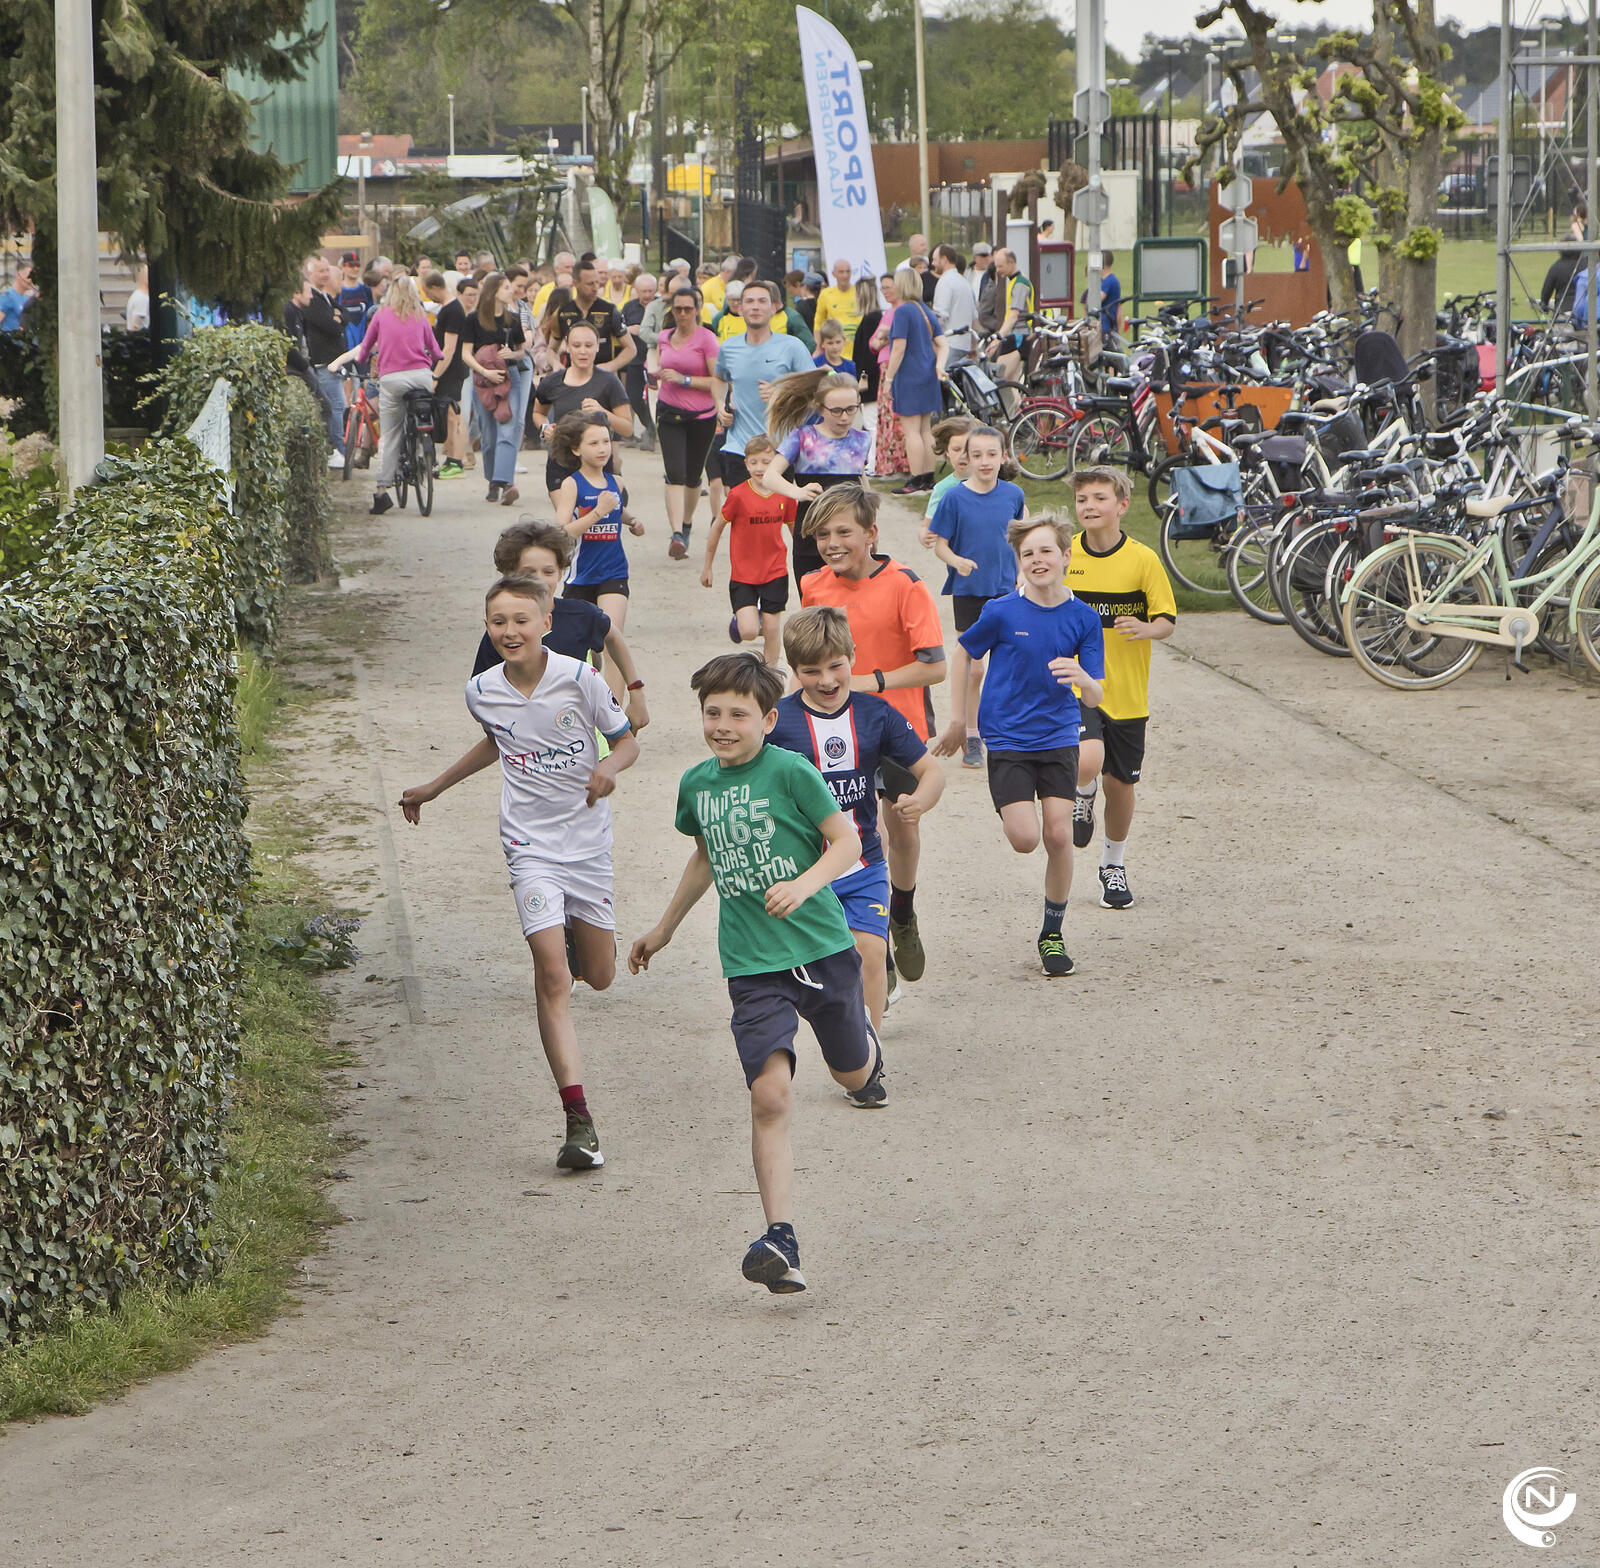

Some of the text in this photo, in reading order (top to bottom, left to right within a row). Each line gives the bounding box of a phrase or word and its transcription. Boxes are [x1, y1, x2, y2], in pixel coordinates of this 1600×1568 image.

[827, 776, 867, 795] ATAR
[837, 789, 866, 805] RWAYS
[696, 784, 750, 827] UNITED
[728, 798, 776, 845] 65
[752, 840, 771, 865] OF
[713, 856, 798, 899] BENETTON
